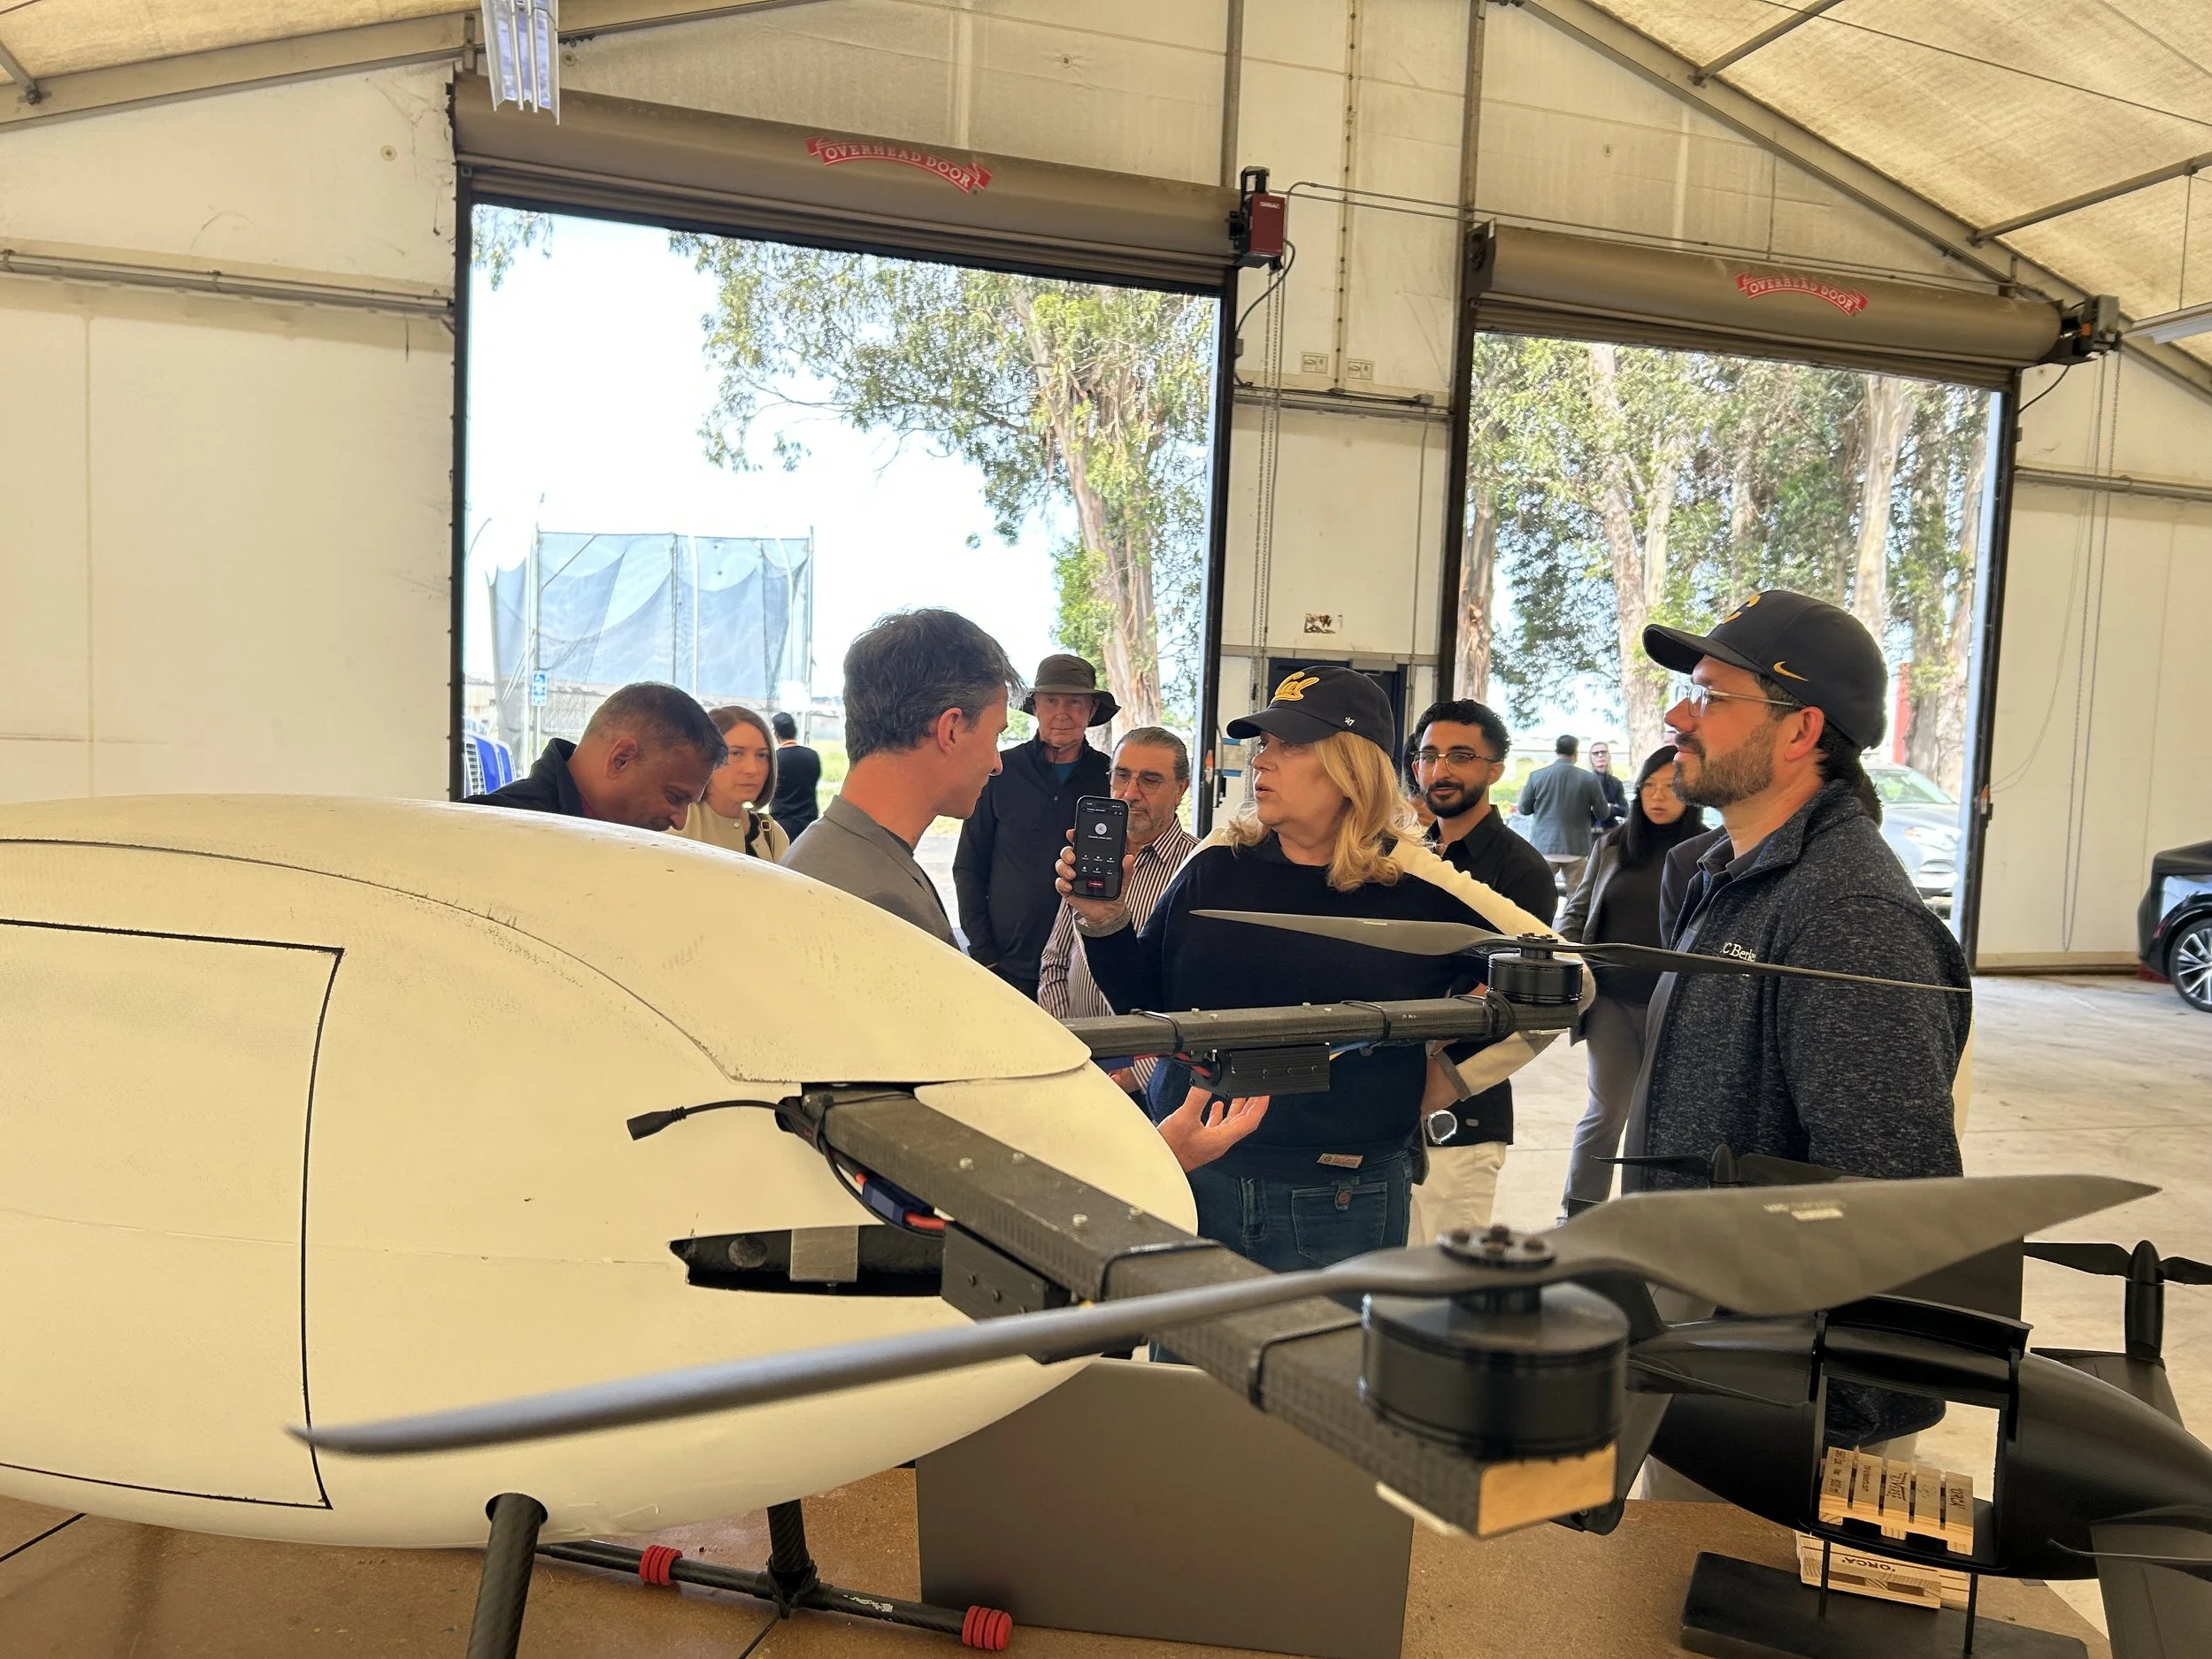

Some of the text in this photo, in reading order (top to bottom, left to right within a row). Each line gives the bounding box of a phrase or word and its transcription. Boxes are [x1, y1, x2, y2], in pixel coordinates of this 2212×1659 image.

[825, 143, 972, 188] OVERHEAD DOOR
[1749, 278, 1854, 311] OVERHEAD DOOR
